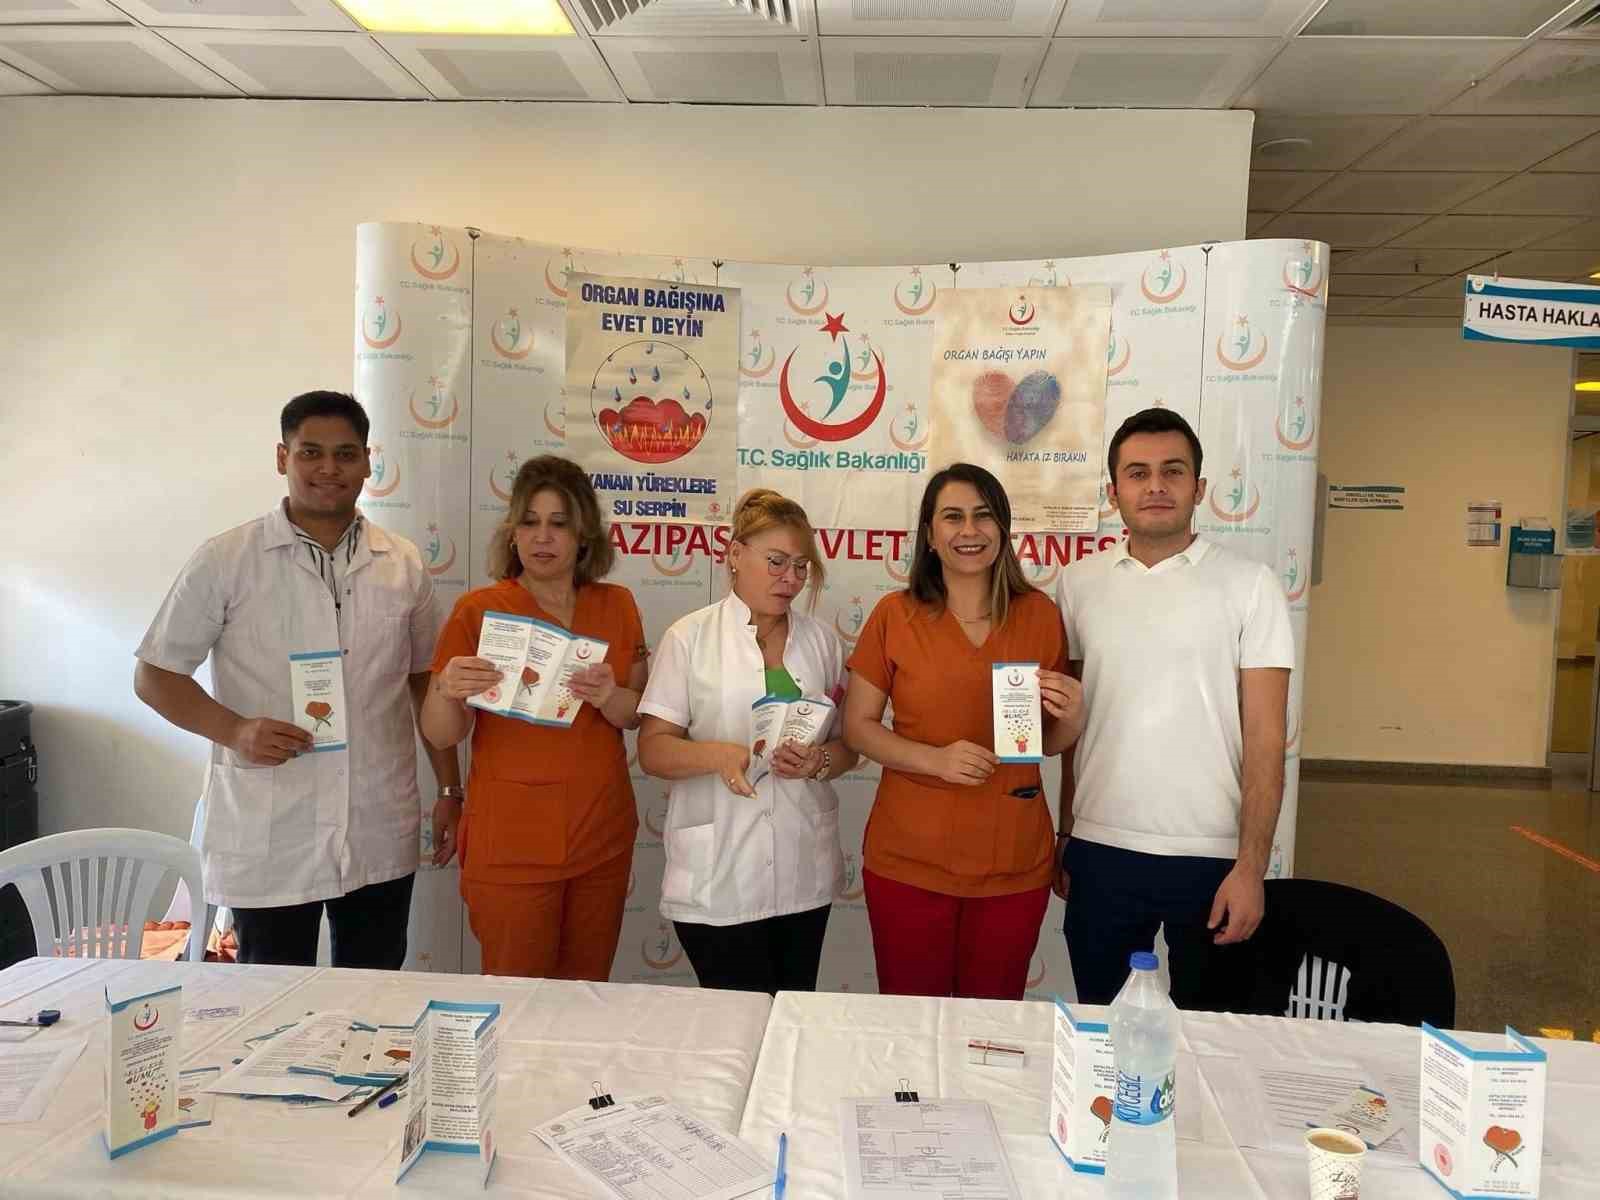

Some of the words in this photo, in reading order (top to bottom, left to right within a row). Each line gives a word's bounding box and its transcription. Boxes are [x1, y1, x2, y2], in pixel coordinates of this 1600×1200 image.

[581, 283, 639, 305] ORGAN
[644, 285, 726, 314] BAĞIŞINA
[1479, 302, 1538, 322] HASTA
[602, 313, 646, 333] EVET
[652, 314, 704, 337] DEYİN
[943, 350, 979, 361] ORGAN
[1016, 348, 1047, 360] YAPIN
[736, 449, 768, 467] T.C.
[771, 449, 831, 471] Sağlık
[836, 451, 926, 474] Bakanlığı
[1007, 452, 1040, 462] HAYATA
[1053, 451, 1087, 463] BIRAKIN
[636, 472, 717, 494] YÜREKLERE
[613, 500, 633, 515] SU
[636, 498, 687, 518] SERPİN
